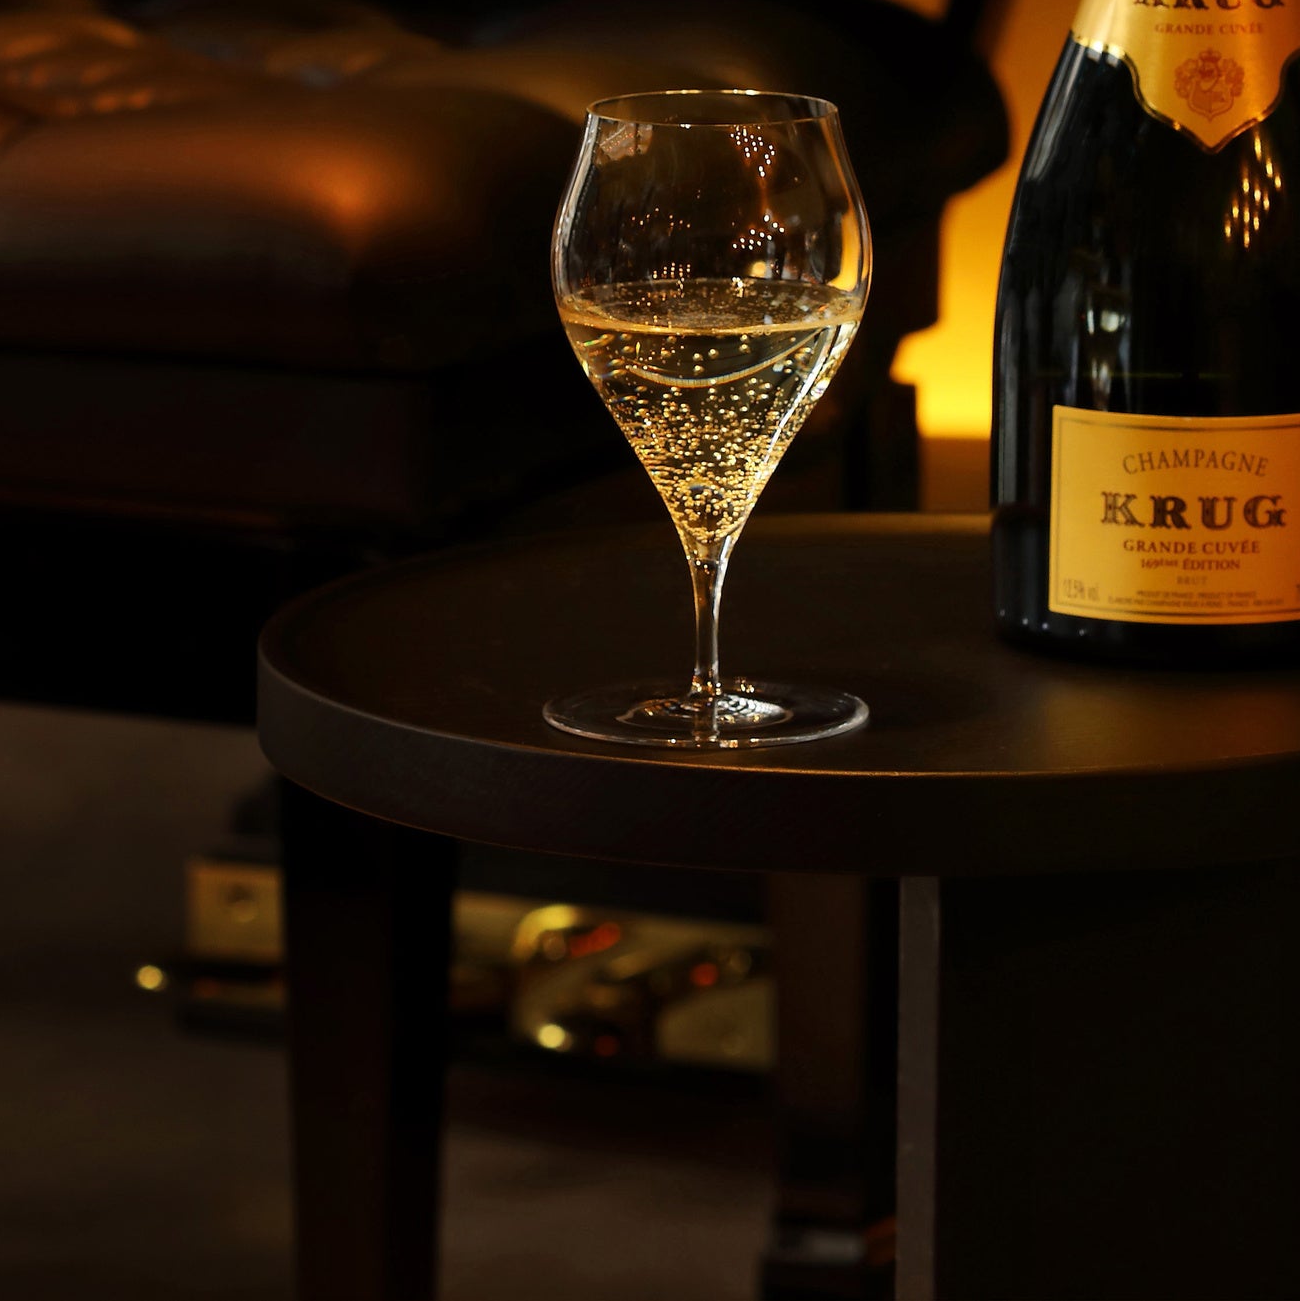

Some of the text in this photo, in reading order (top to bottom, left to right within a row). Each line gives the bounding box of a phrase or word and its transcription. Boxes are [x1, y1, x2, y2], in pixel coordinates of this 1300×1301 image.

[1155, 22, 1214, 35] GRANDE
[1122, 449, 1269, 477] CHAMPAGNE
[1101, 491, 1287, 530] KRUG
[1123, 539, 1261, 554] GRANDE CUVÉE
[1182, 557, 1241, 570] ÉDITION
